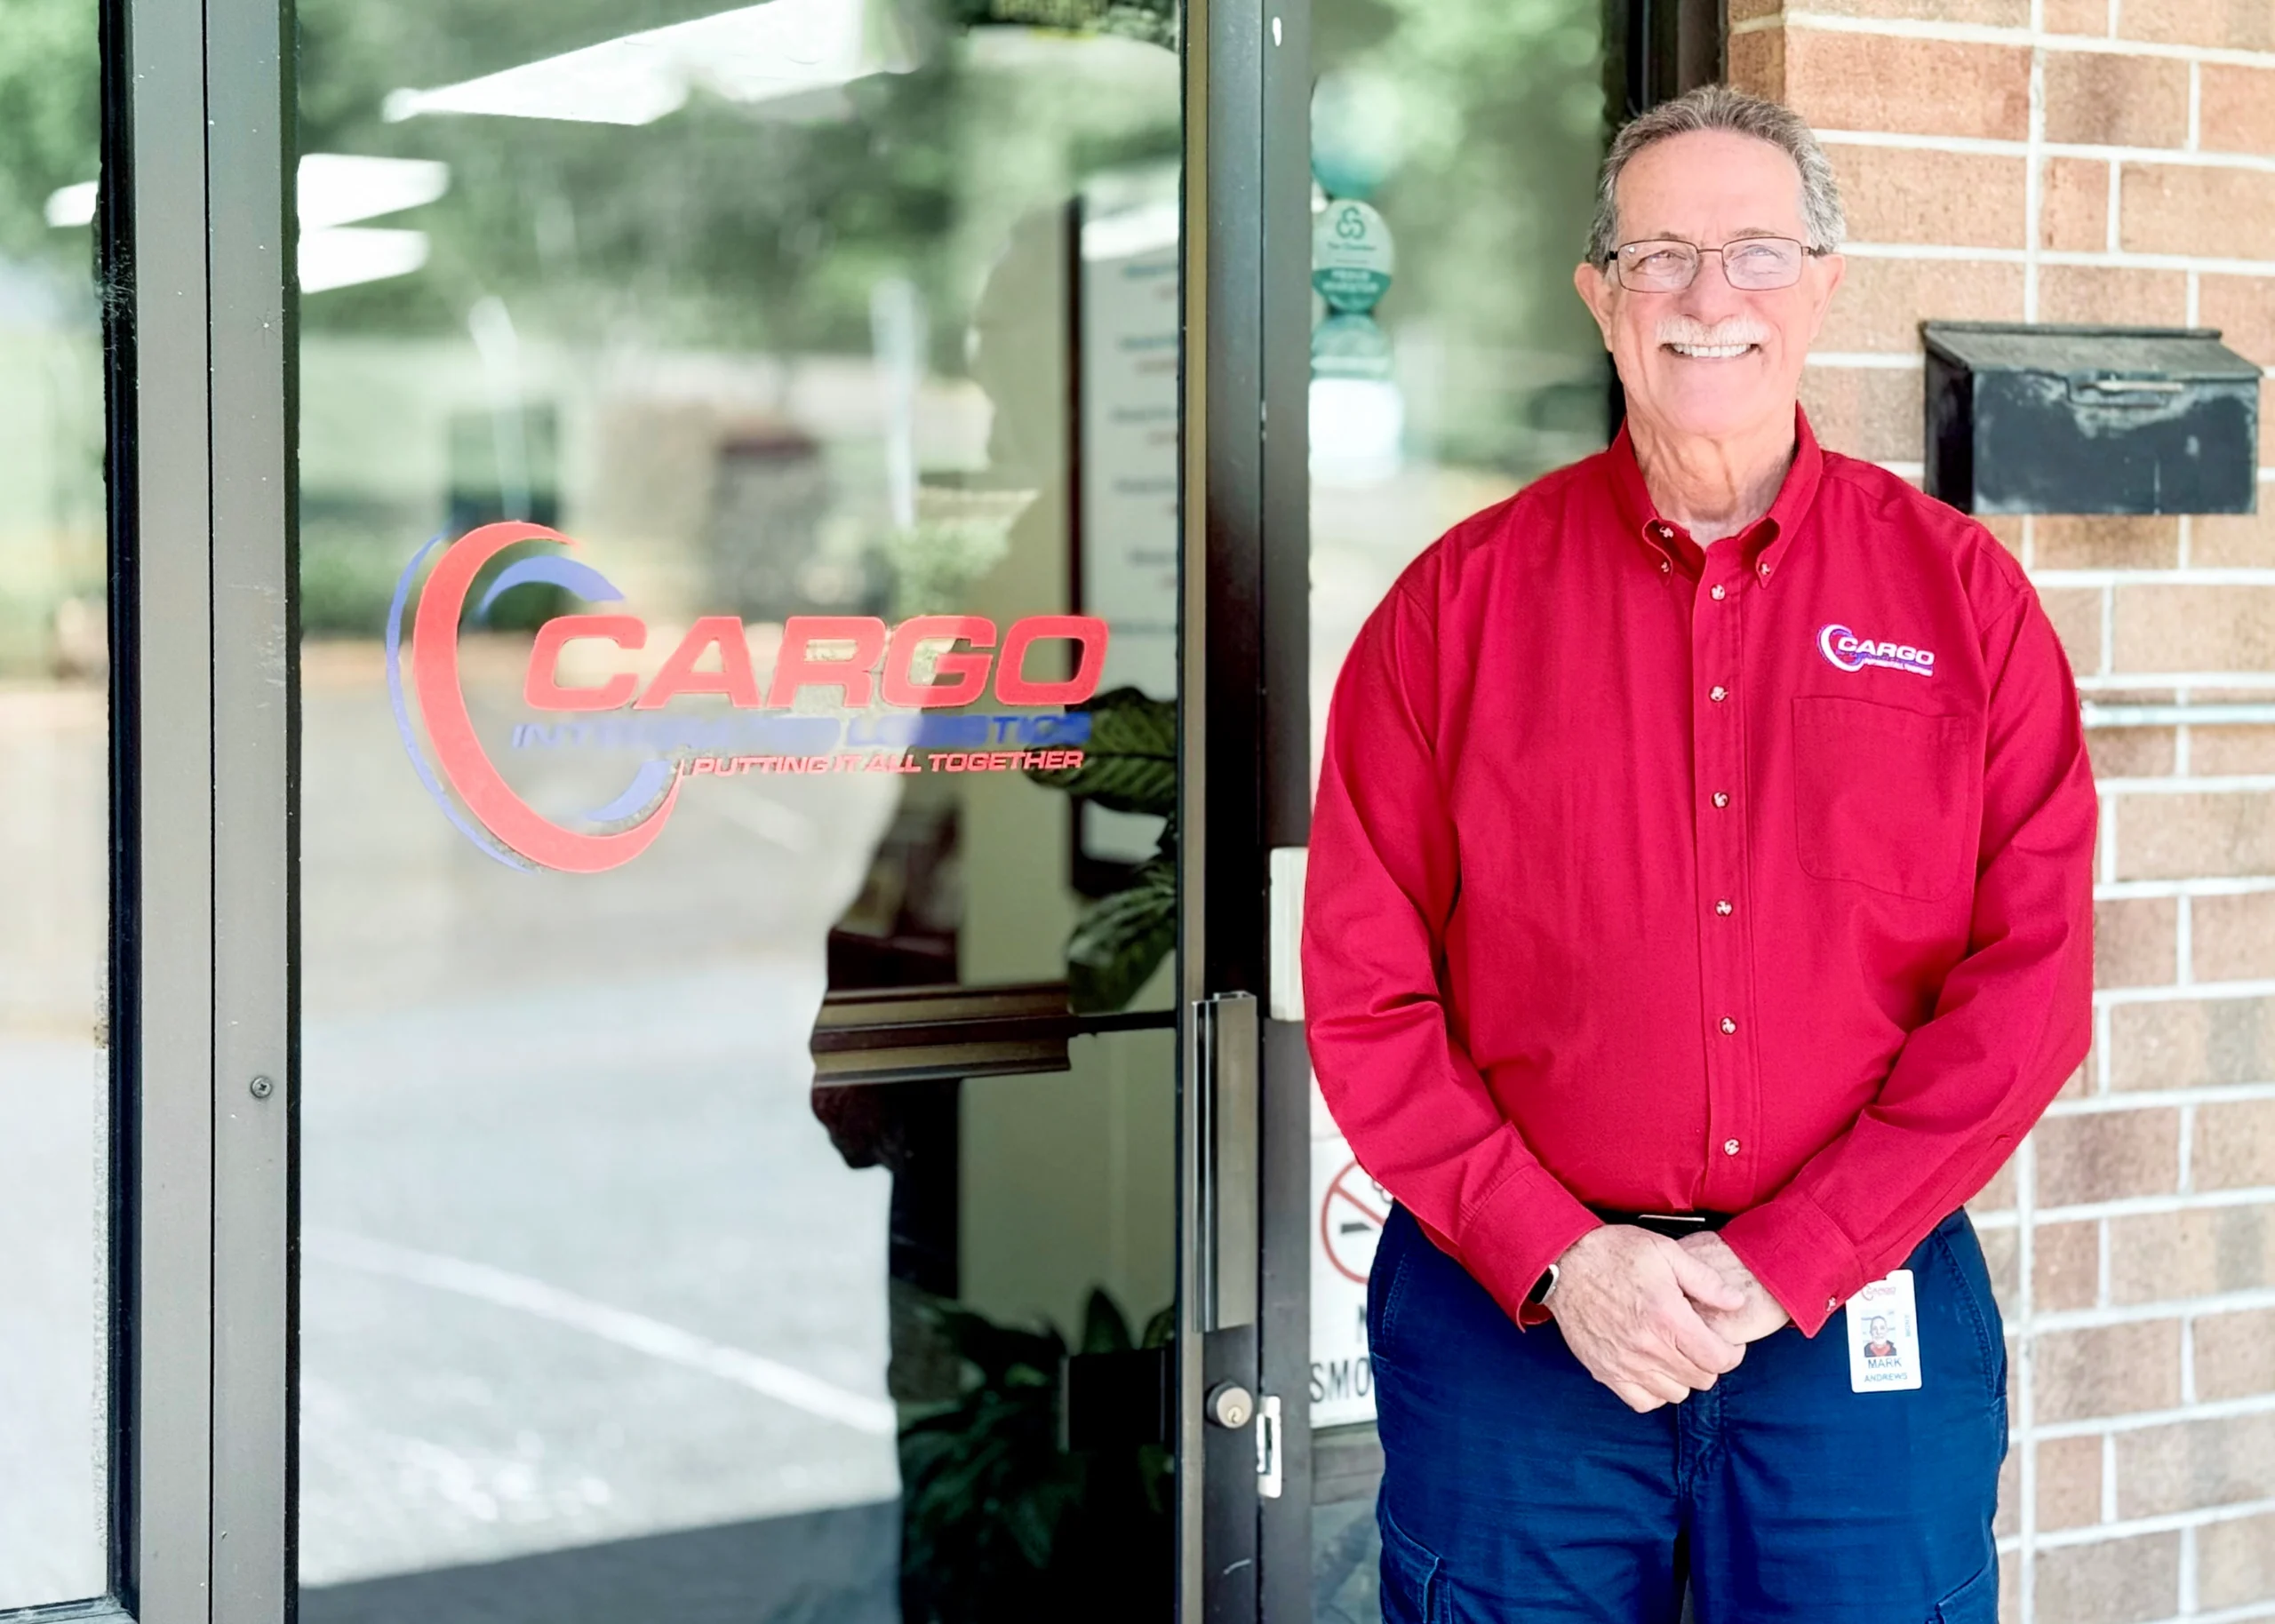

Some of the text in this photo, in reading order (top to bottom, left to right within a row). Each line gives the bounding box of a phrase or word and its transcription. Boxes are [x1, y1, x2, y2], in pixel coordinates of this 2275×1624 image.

[523, 615, 1109, 711] CARGO
[1838, 636, 1935, 665] CARGO
[691, 751, 1085, 776] PUTTING IT ALL TOGETHER
[1868, 1357, 1902, 1368] MARK
[1864, 1373, 1908, 1382] ANDREWS
